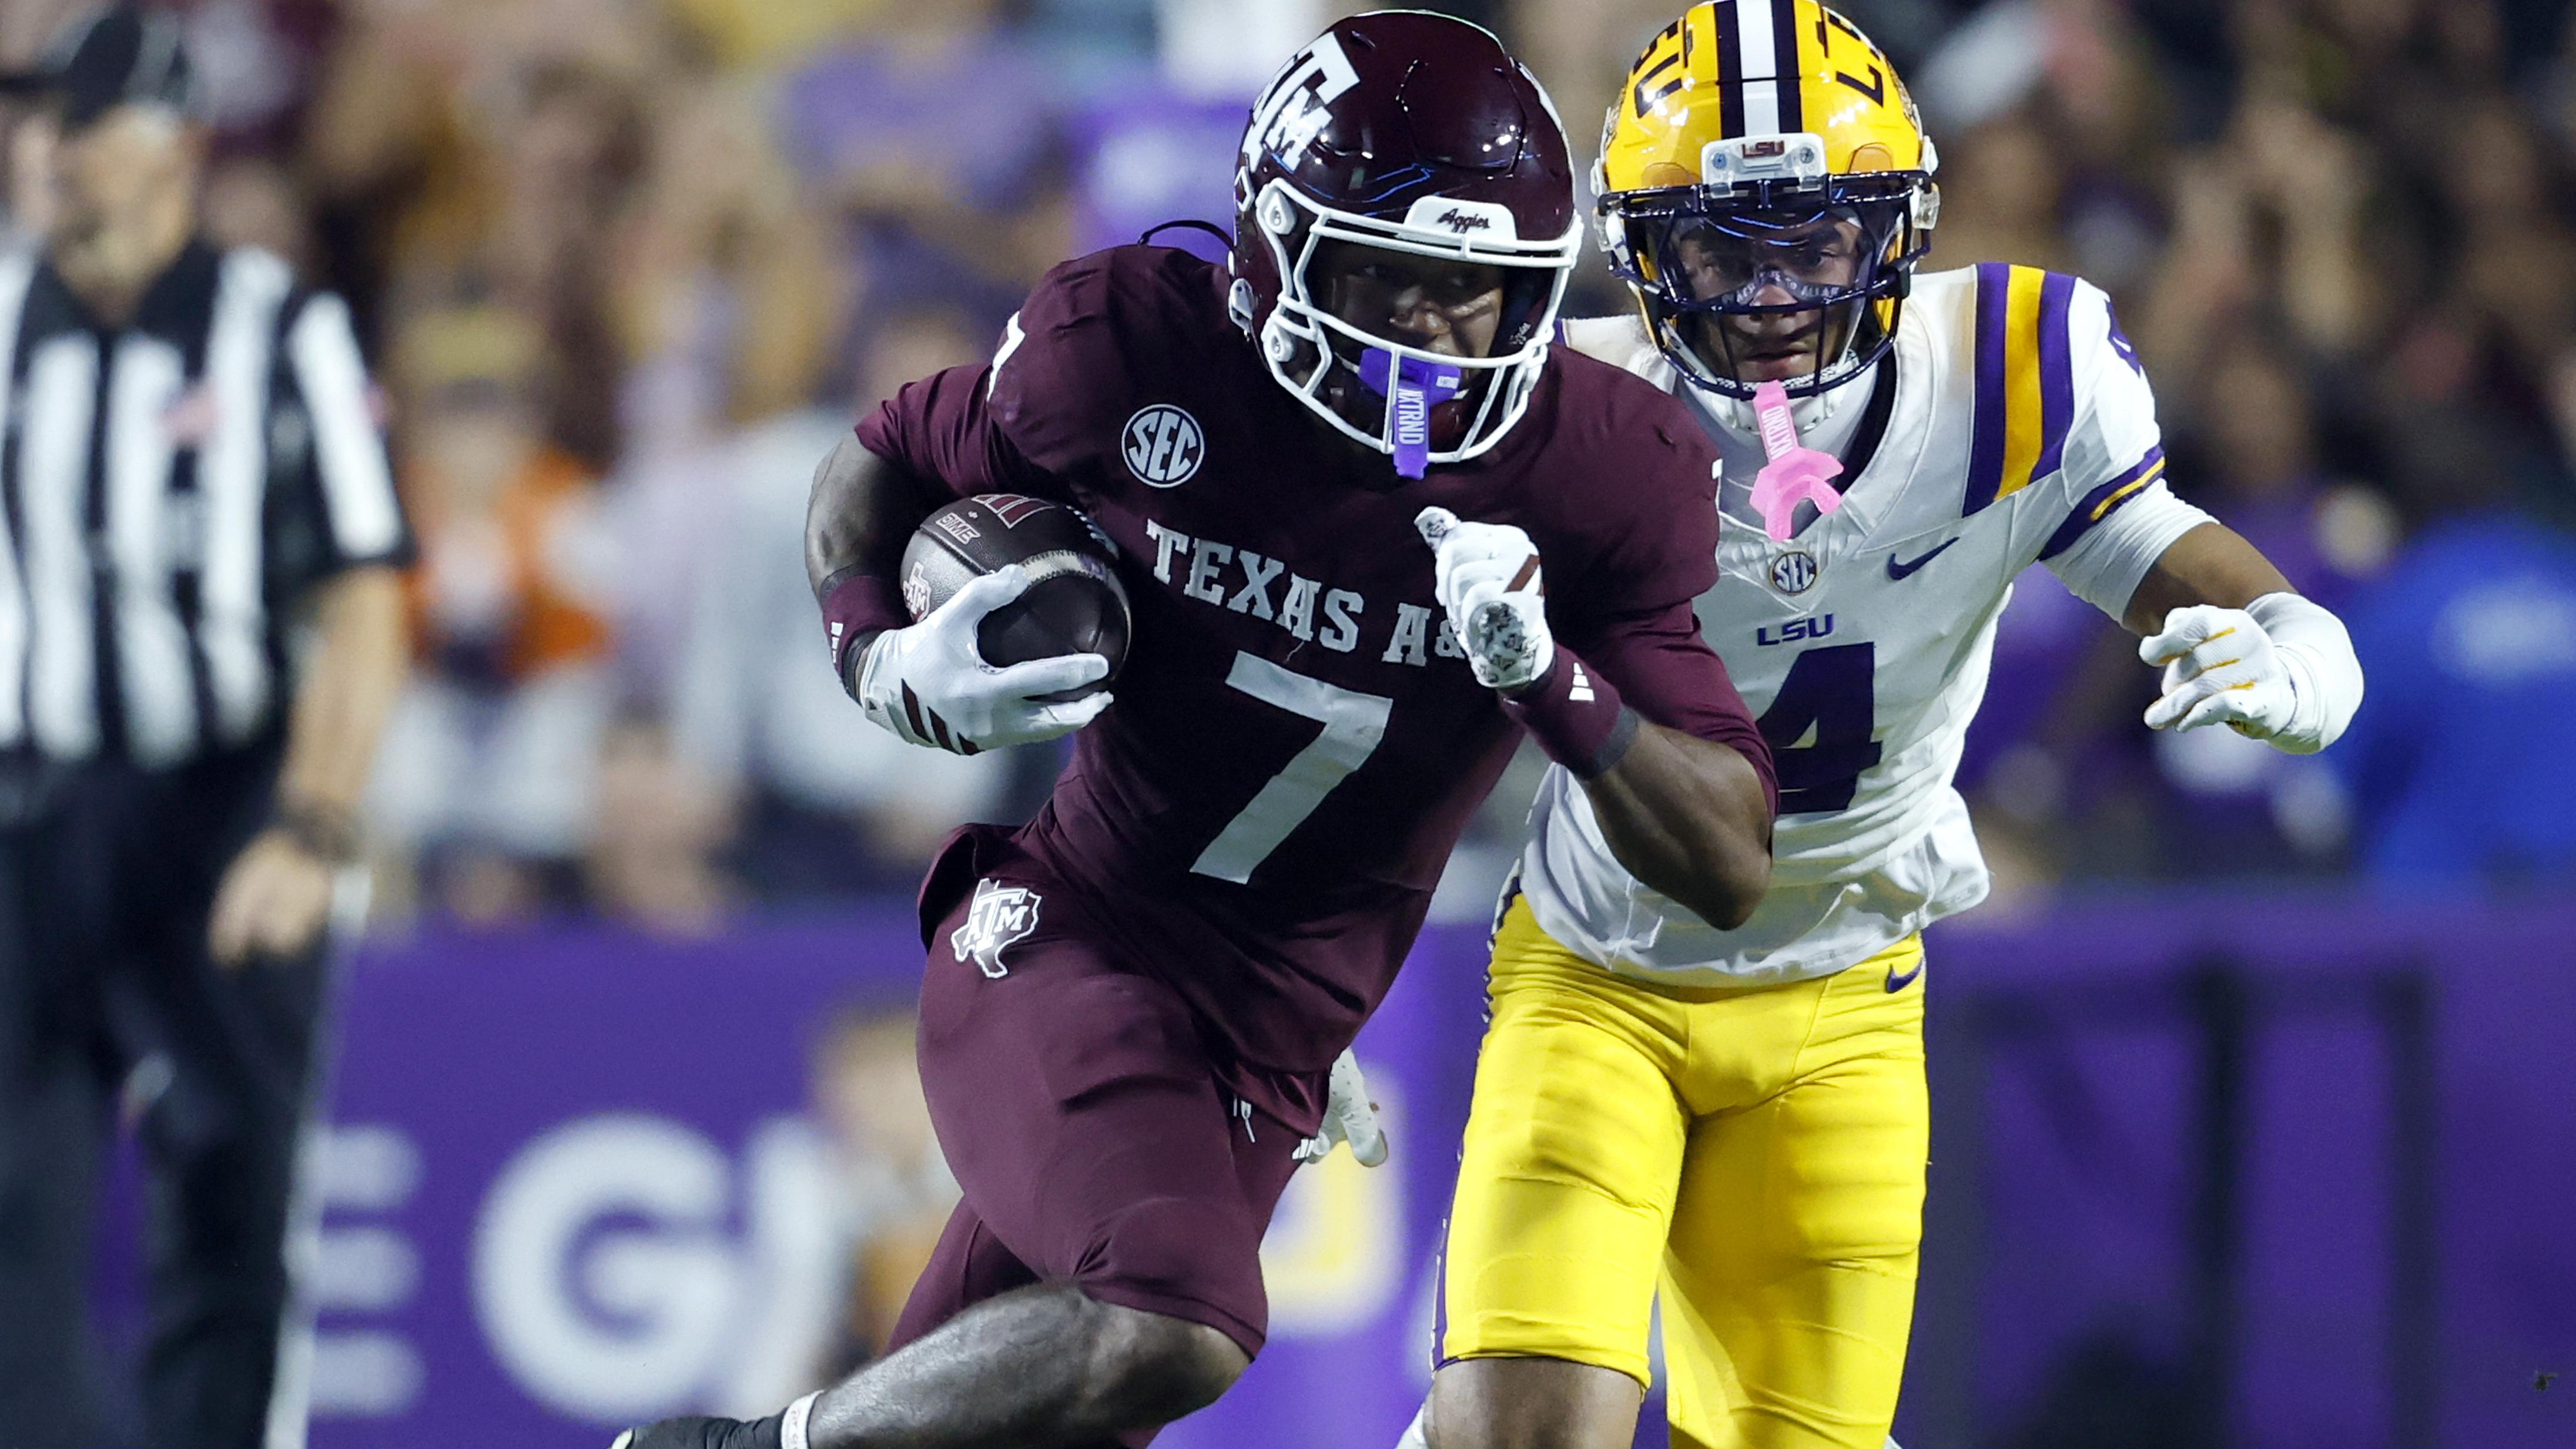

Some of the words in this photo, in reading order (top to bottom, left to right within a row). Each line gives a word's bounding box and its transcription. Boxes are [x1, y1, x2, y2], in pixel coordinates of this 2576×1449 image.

[1741, 140, 1785, 159] LSU
[1437, 207, 1490, 234] Aggies
[1128, 411, 1198, 481] SEC
[1761, 405, 1794, 460] NXTRND
[1147, 518, 1364, 653] TEXAS
[1382, 602, 1466, 667] A&
[1774, 553, 1817, 592] SEC
[1757, 612, 1834, 646] LSU
[1756, 642, 1882, 814] 4
[1190, 650, 1393, 885] 7
